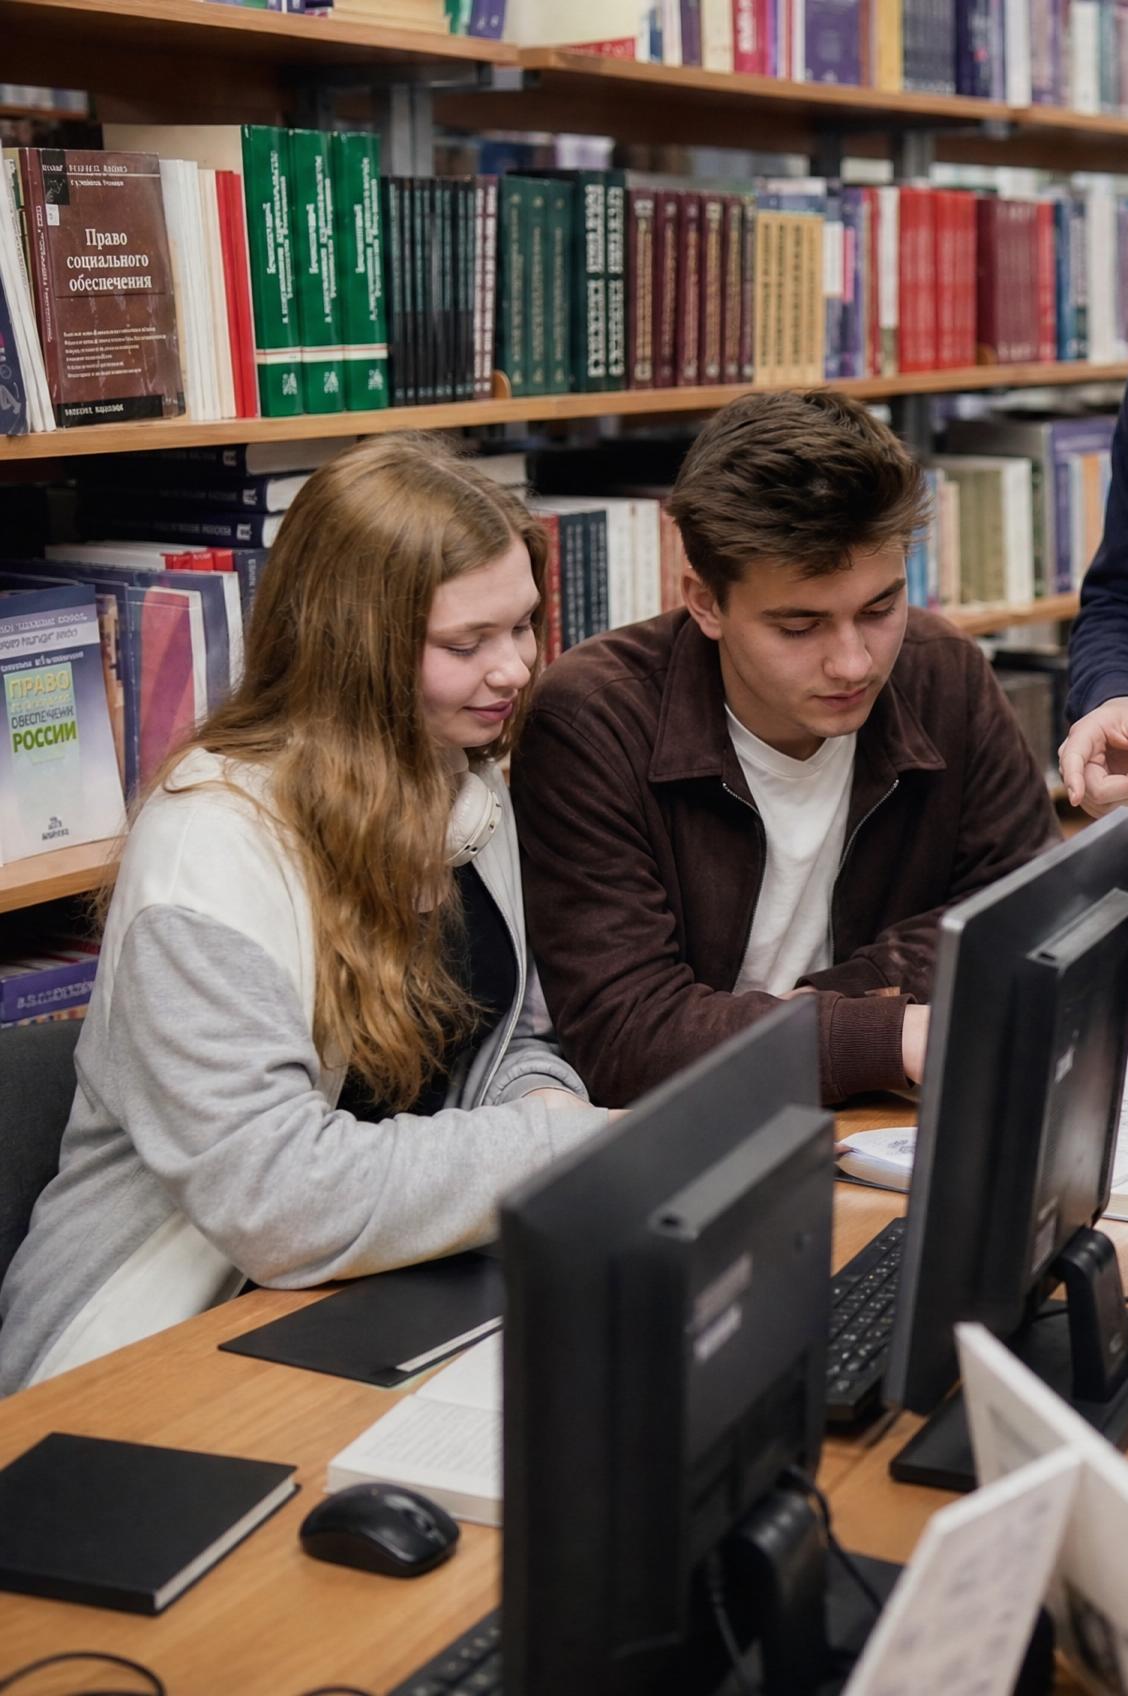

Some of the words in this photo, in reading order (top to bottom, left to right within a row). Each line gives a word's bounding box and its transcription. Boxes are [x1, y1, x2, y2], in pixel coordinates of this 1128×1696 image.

[85, 228, 128, 250] Право
[66, 255, 149, 271] социального
[69, 274, 152, 291] обеспечения
[9, 671, 70, 699] ПРАВО
[12, 720, 76, 753] РОССИИ
